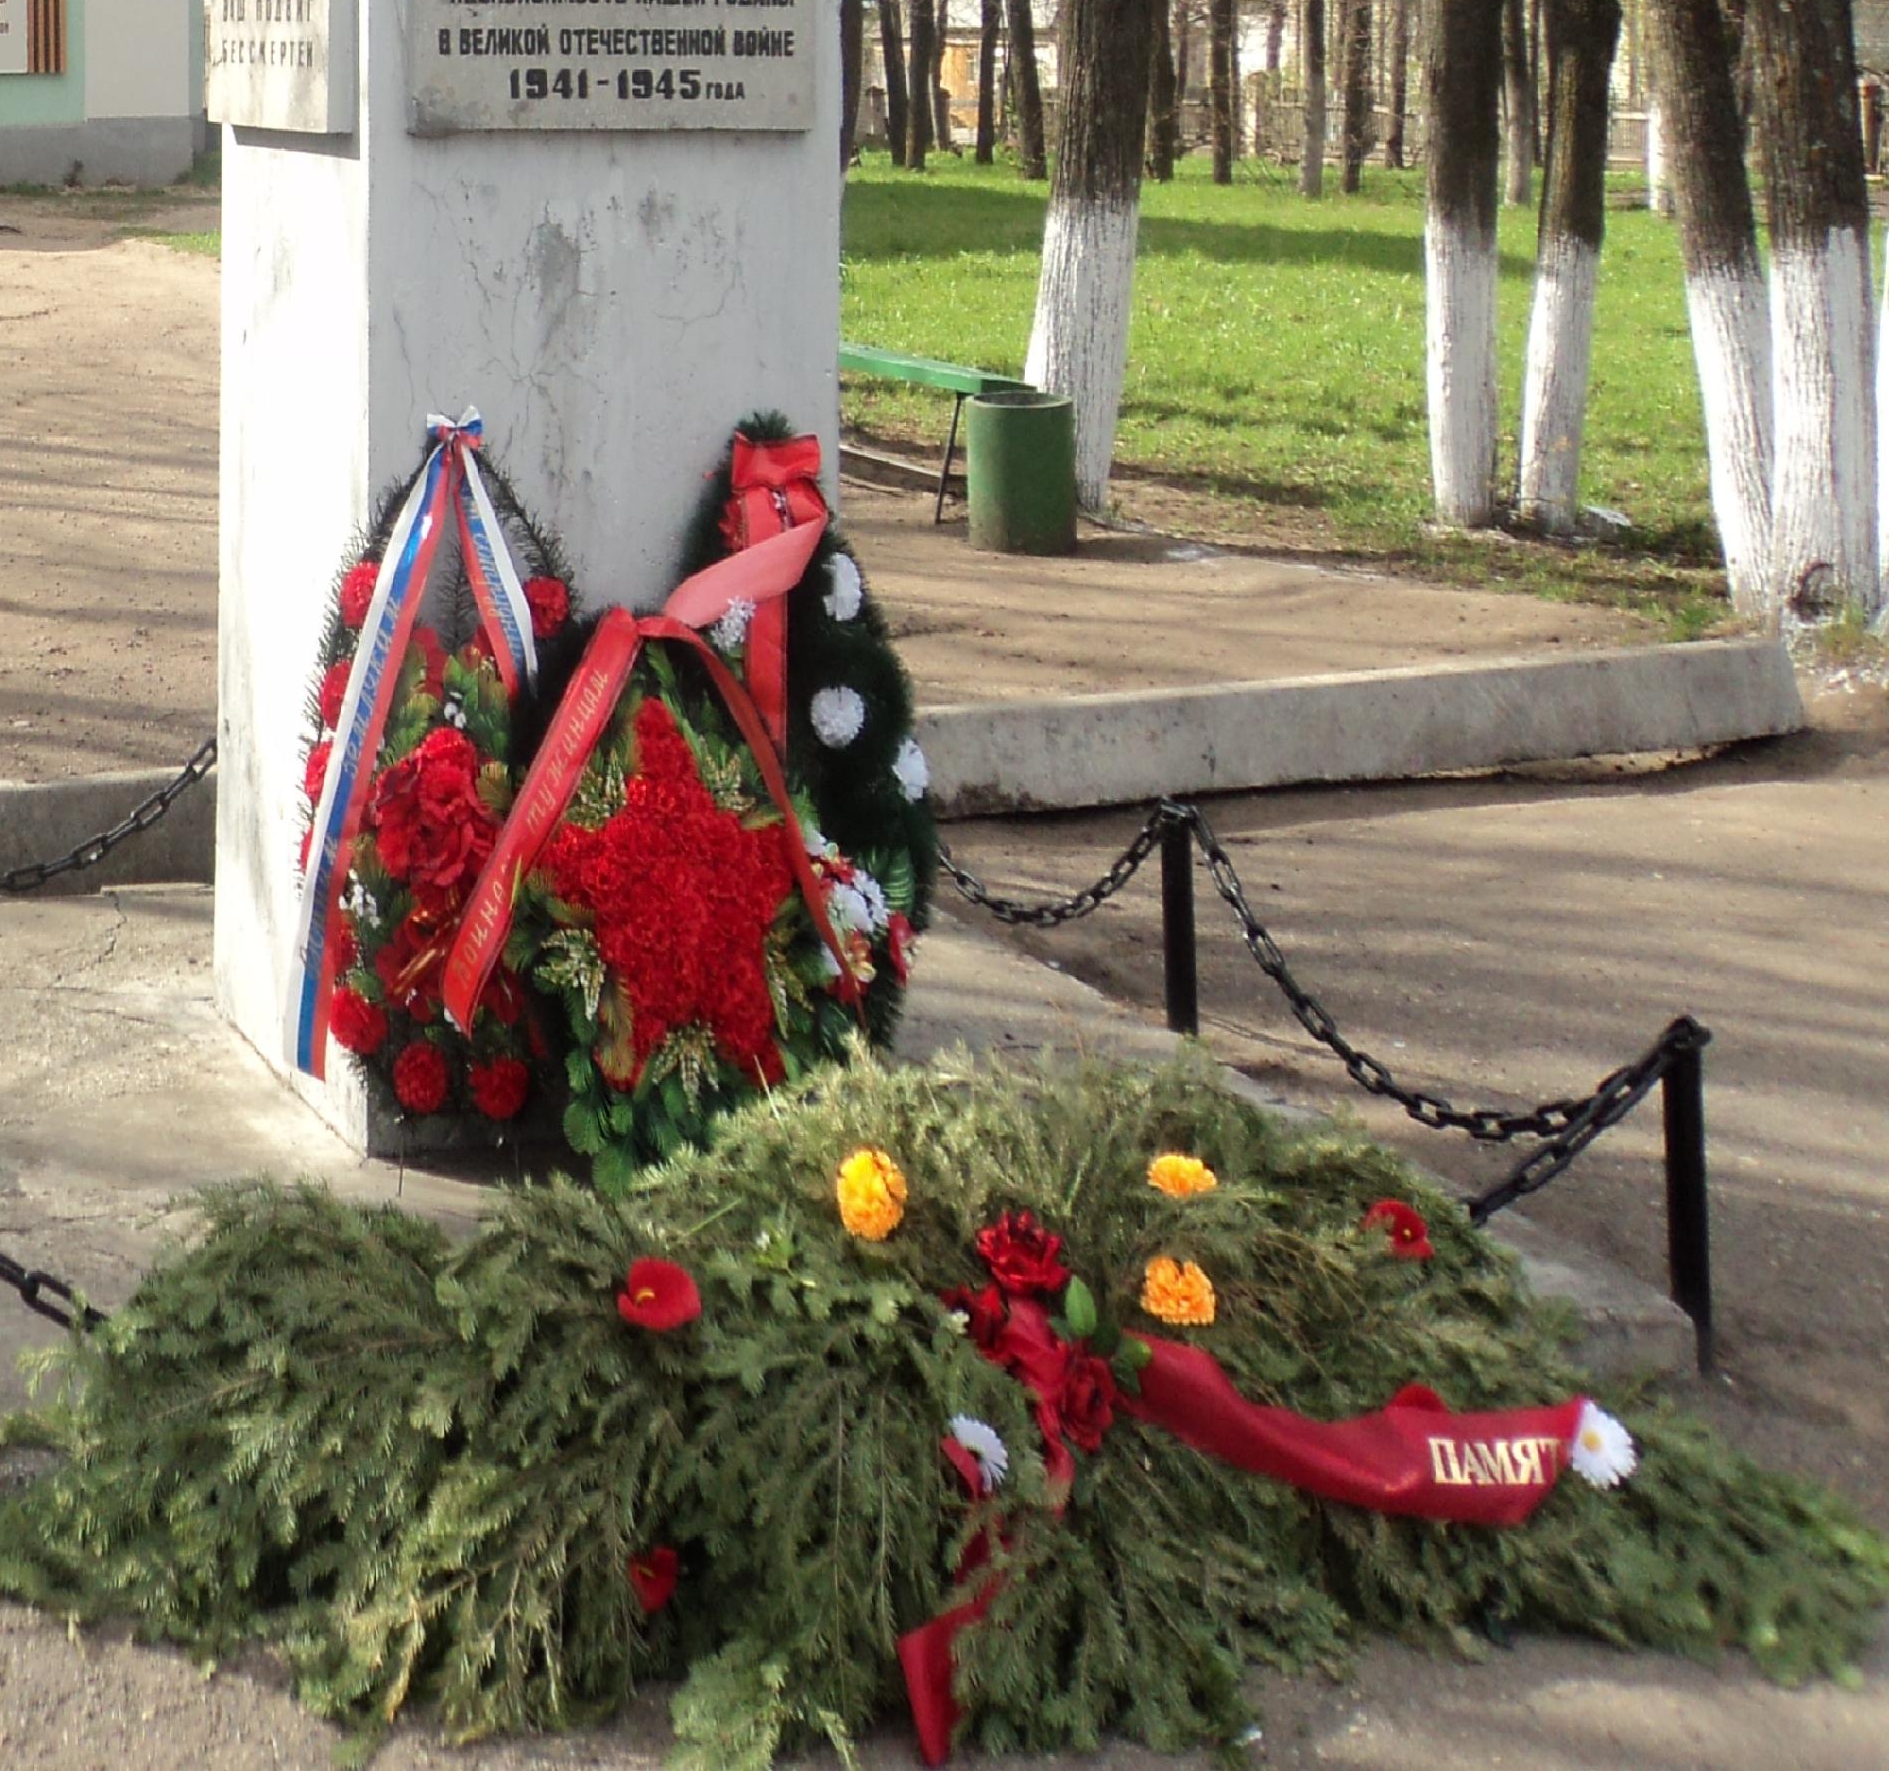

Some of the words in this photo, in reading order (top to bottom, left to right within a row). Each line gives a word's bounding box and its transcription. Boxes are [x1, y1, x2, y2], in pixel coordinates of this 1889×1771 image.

[222, 39, 313, 68] БЕССМЕРТЕН
[439, 28, 451, 55] В
[460, 23, 550, 55] ВЕЛИКОЙ
[560, 24, 726, 56] ОТЕЧЕСТВЕННОЙ
[734, 25, 794, 56] ВОЙНЕ
